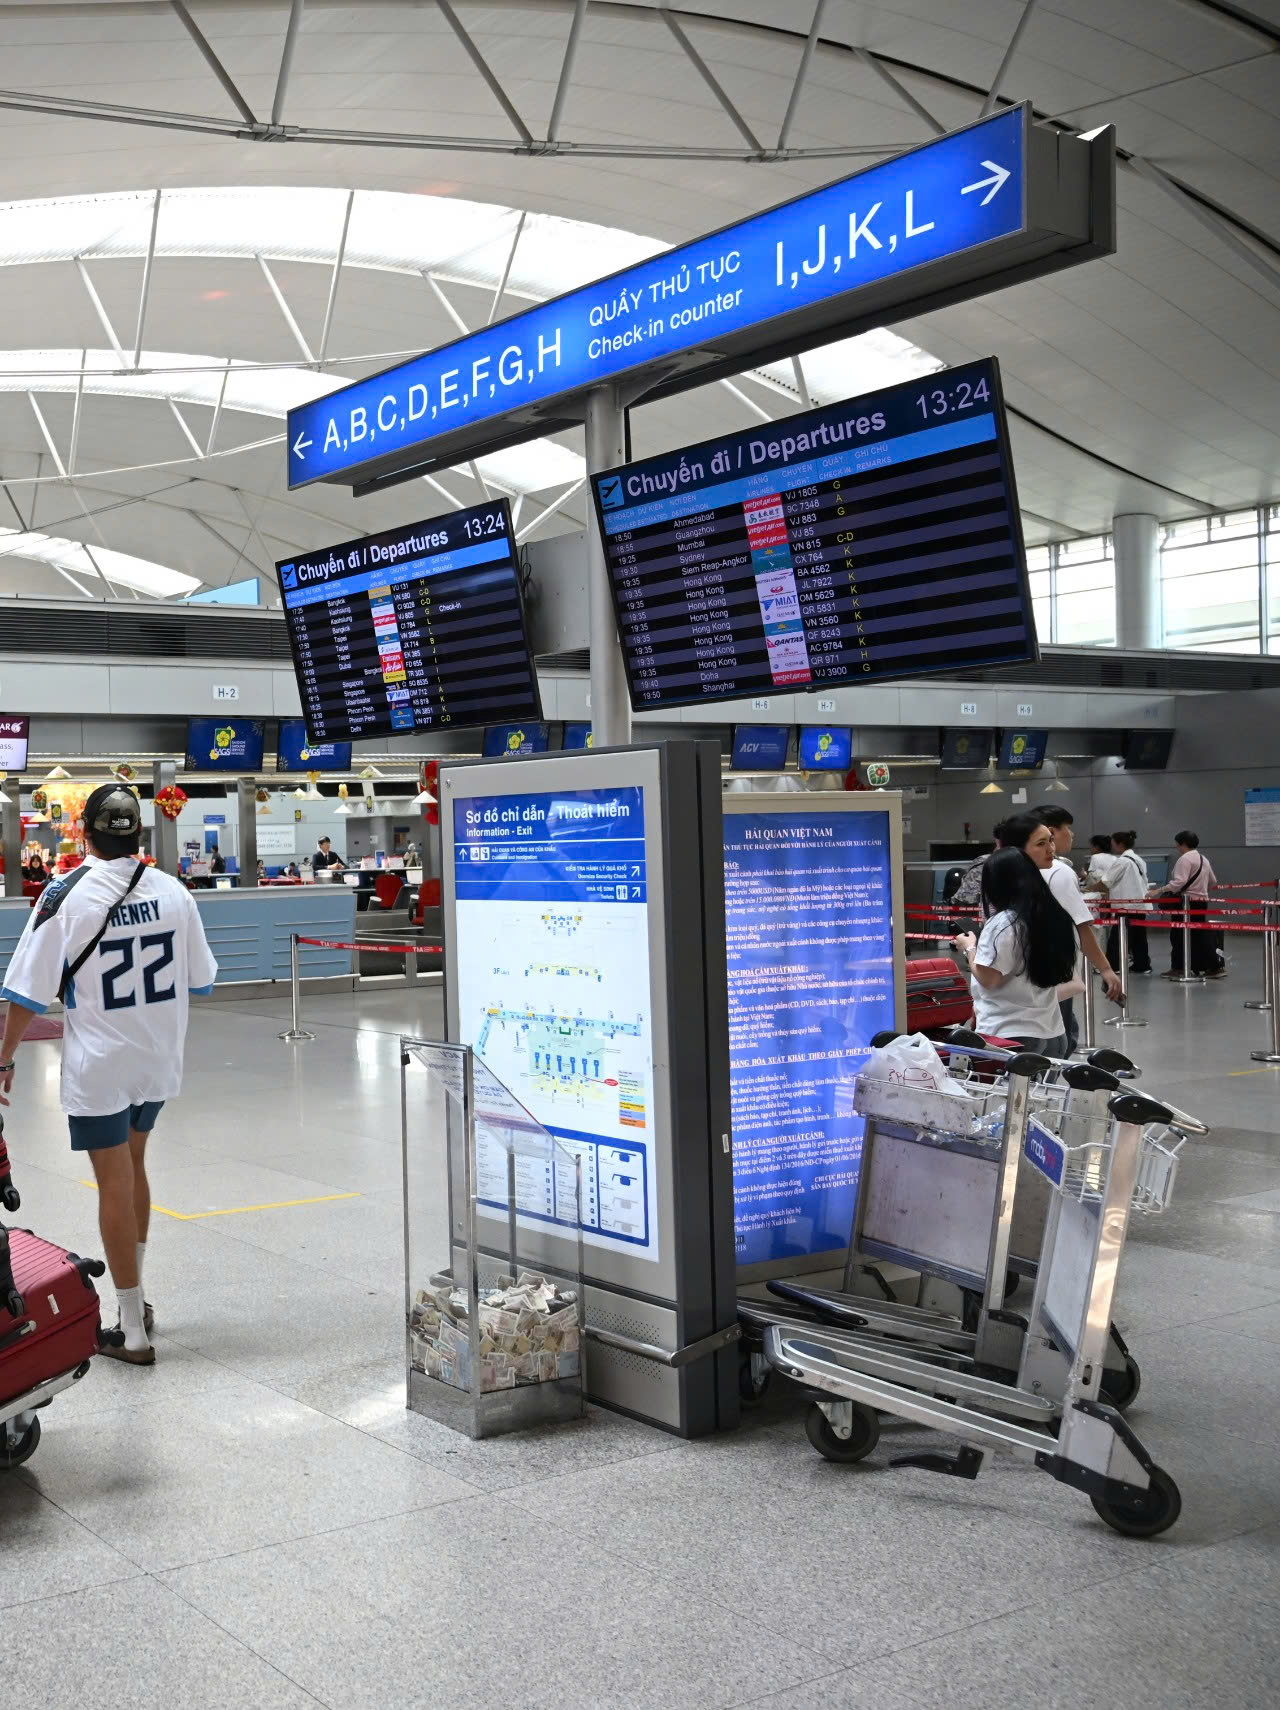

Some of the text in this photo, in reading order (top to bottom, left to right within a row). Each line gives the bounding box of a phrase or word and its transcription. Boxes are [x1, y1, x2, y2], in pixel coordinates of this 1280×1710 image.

[776, 190, 934, 289] I,J,K,L
[589, 251, 740, 326] QUẦY THỦ TỤC
[588, 289, 742, 359] Check-in counter
[323, 328, 560, 453] A,B,C,D,E,F,G,H
[916, 377, 990, 418] 13:24
[627, 412, 885, 496] Chuyến đi / Departures
[464, 512, 504, 538] 13:24
[615, 480, 840, 542] 18:50 Ahmedabad VJ 1805 G
[617, 494, 842, 553] 18:55 Guangzhou 9C 7348 A
[298, 553, 345, 580] Chuyến
[348, 550, 360, 568] đi
[370, 531, 448, 562] Departures
[619, 506, 845, 564] 19:25 Mumbai VJ 883 G
[620, 526, 814, 576] 19:30 Sydney VJ 85
[623, 532, 853, 587] 19:35 Siem Reap-Angkor VN 815 C-D
[625, 545, 851, 598] 19:35 Hong Kong CX 764 K
[627, 600, 644, 609] 19:35
[685, 590, 704, 598] Hong
[705, 586, 724, 595] Kong
[797, 568, 809, 576] BA
[846, 559, 853, 567] K
[629, 571, 855, 621] 19:35 Hong Kong JL 7922 K
[438, 602, 461, 612] Check-in
[631, 622, 648, 632] 19:35
[689, 613, 708, 622] Hong
[709, 610, 728, 619] Kong
[799, 593, 813, 602] OM
[850, 585, 857, 594] K
[633, 597, 860, 643] 19:35 Hong Kong QR 5831 K
[635, 611, 861, 654] 19:35 Hong Kong VN 3560 K
[637, 623, 863, 665] 19:35 Hong Kong QANTAS QF 8243 K
[639, 637, 865, 677] 19:35 Hong Kong AC 9784 K
[641, 650, 867, 688] 19:40 Doha QR 971 H
[218, 688, 236, 698] H-2
[643, 663, 870, 699] 19:50 Shanghai VJ 3900 G
[755, 700, 768, 709] H-6
[821, 702, 833, 710] H-7
[963, 705, 975, 713] H-8
[1020, 705, 1031, 713] H-9
[740, 743, 760, 752] ACV
[466, 810, 481, 823] Sơ
[483, 806, 498, 823] đồ
[501, 806, 519, 822] chỉ
[522, 804, 545, 821] dẫn
[557, 803, 593, 820] Thoát
[597, 799, 630, 818] hiểm
[466, 826, 510, 838] Information
[516, 825, 533, 836] Exit
[745, 827, 833, 840] HẢI QUAN VIỆT NAM
[110, 899, 161, 927] HENRY
[100, 929, 176, 1011] 22
